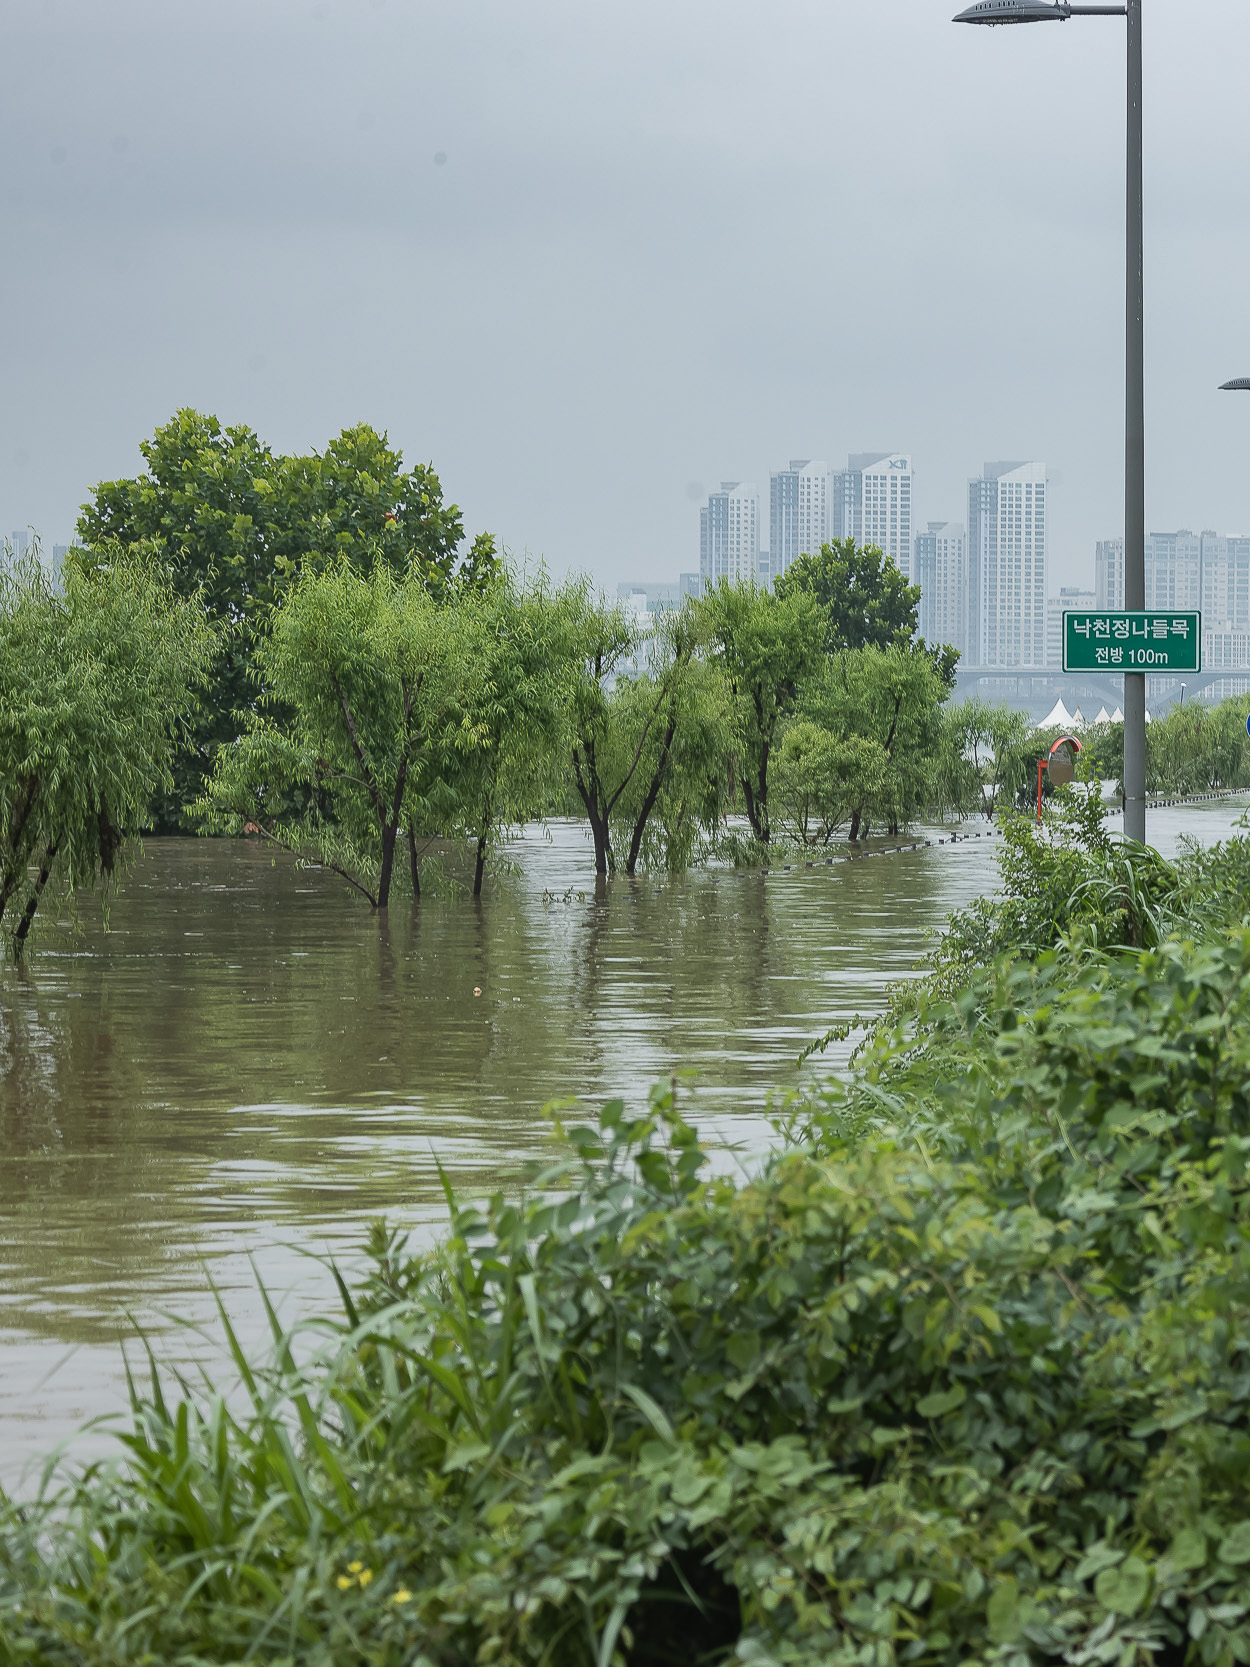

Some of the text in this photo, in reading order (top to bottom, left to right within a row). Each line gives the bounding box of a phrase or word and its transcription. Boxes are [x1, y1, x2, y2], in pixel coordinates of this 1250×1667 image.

[1073, 618, 1190, 639] 낙천정나들목
[1095, 646, 1169, 664] 전방 100m
